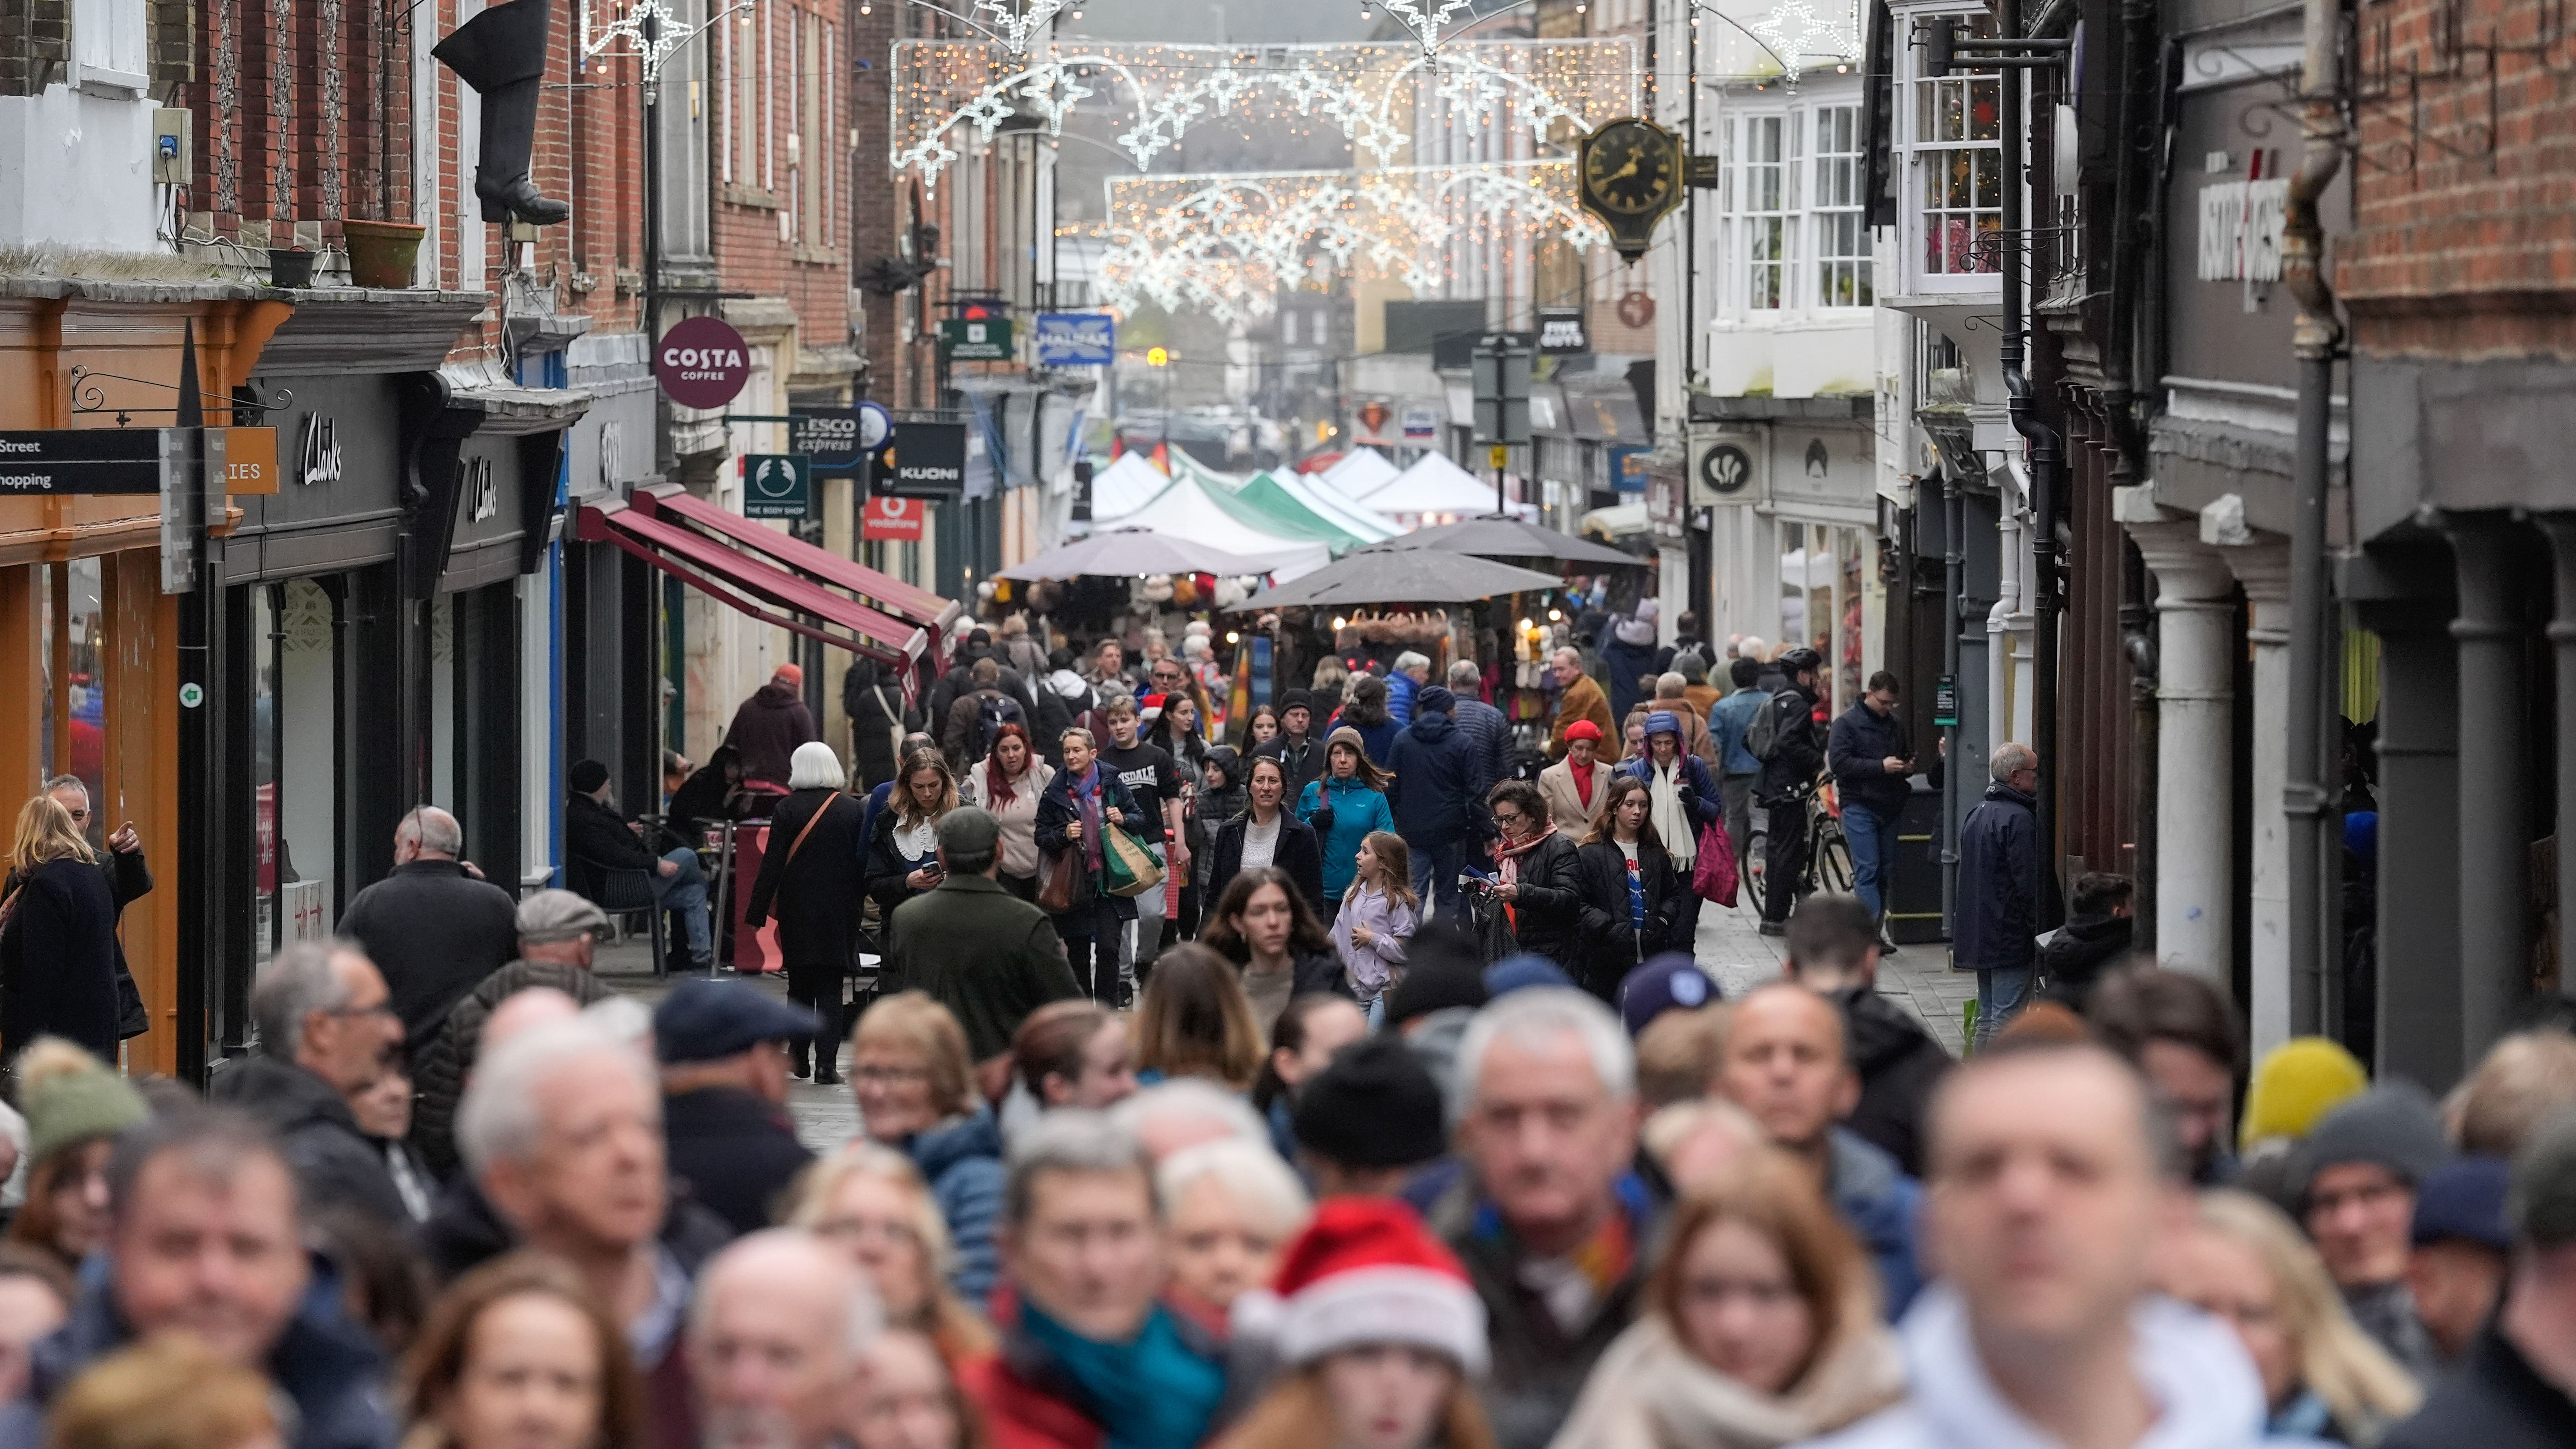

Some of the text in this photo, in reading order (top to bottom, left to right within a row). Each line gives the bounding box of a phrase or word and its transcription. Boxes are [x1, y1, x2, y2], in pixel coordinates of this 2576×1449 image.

[663, 347, 742, 370] COSTA
[681, 371, 725, 381] COFFEE
[0, 439, 41, 453] Street
[304, 411, 341, 485] Clarks
[797, 438, 853, 454] express
[229, 464, 261, 479] IES
[900, 467, 959, 480] KUONI
[0, 473, 52, 489] hopping
[475, 457, 497, 524] Clarks
[1118, 765, 1155, 783] NSDALE
